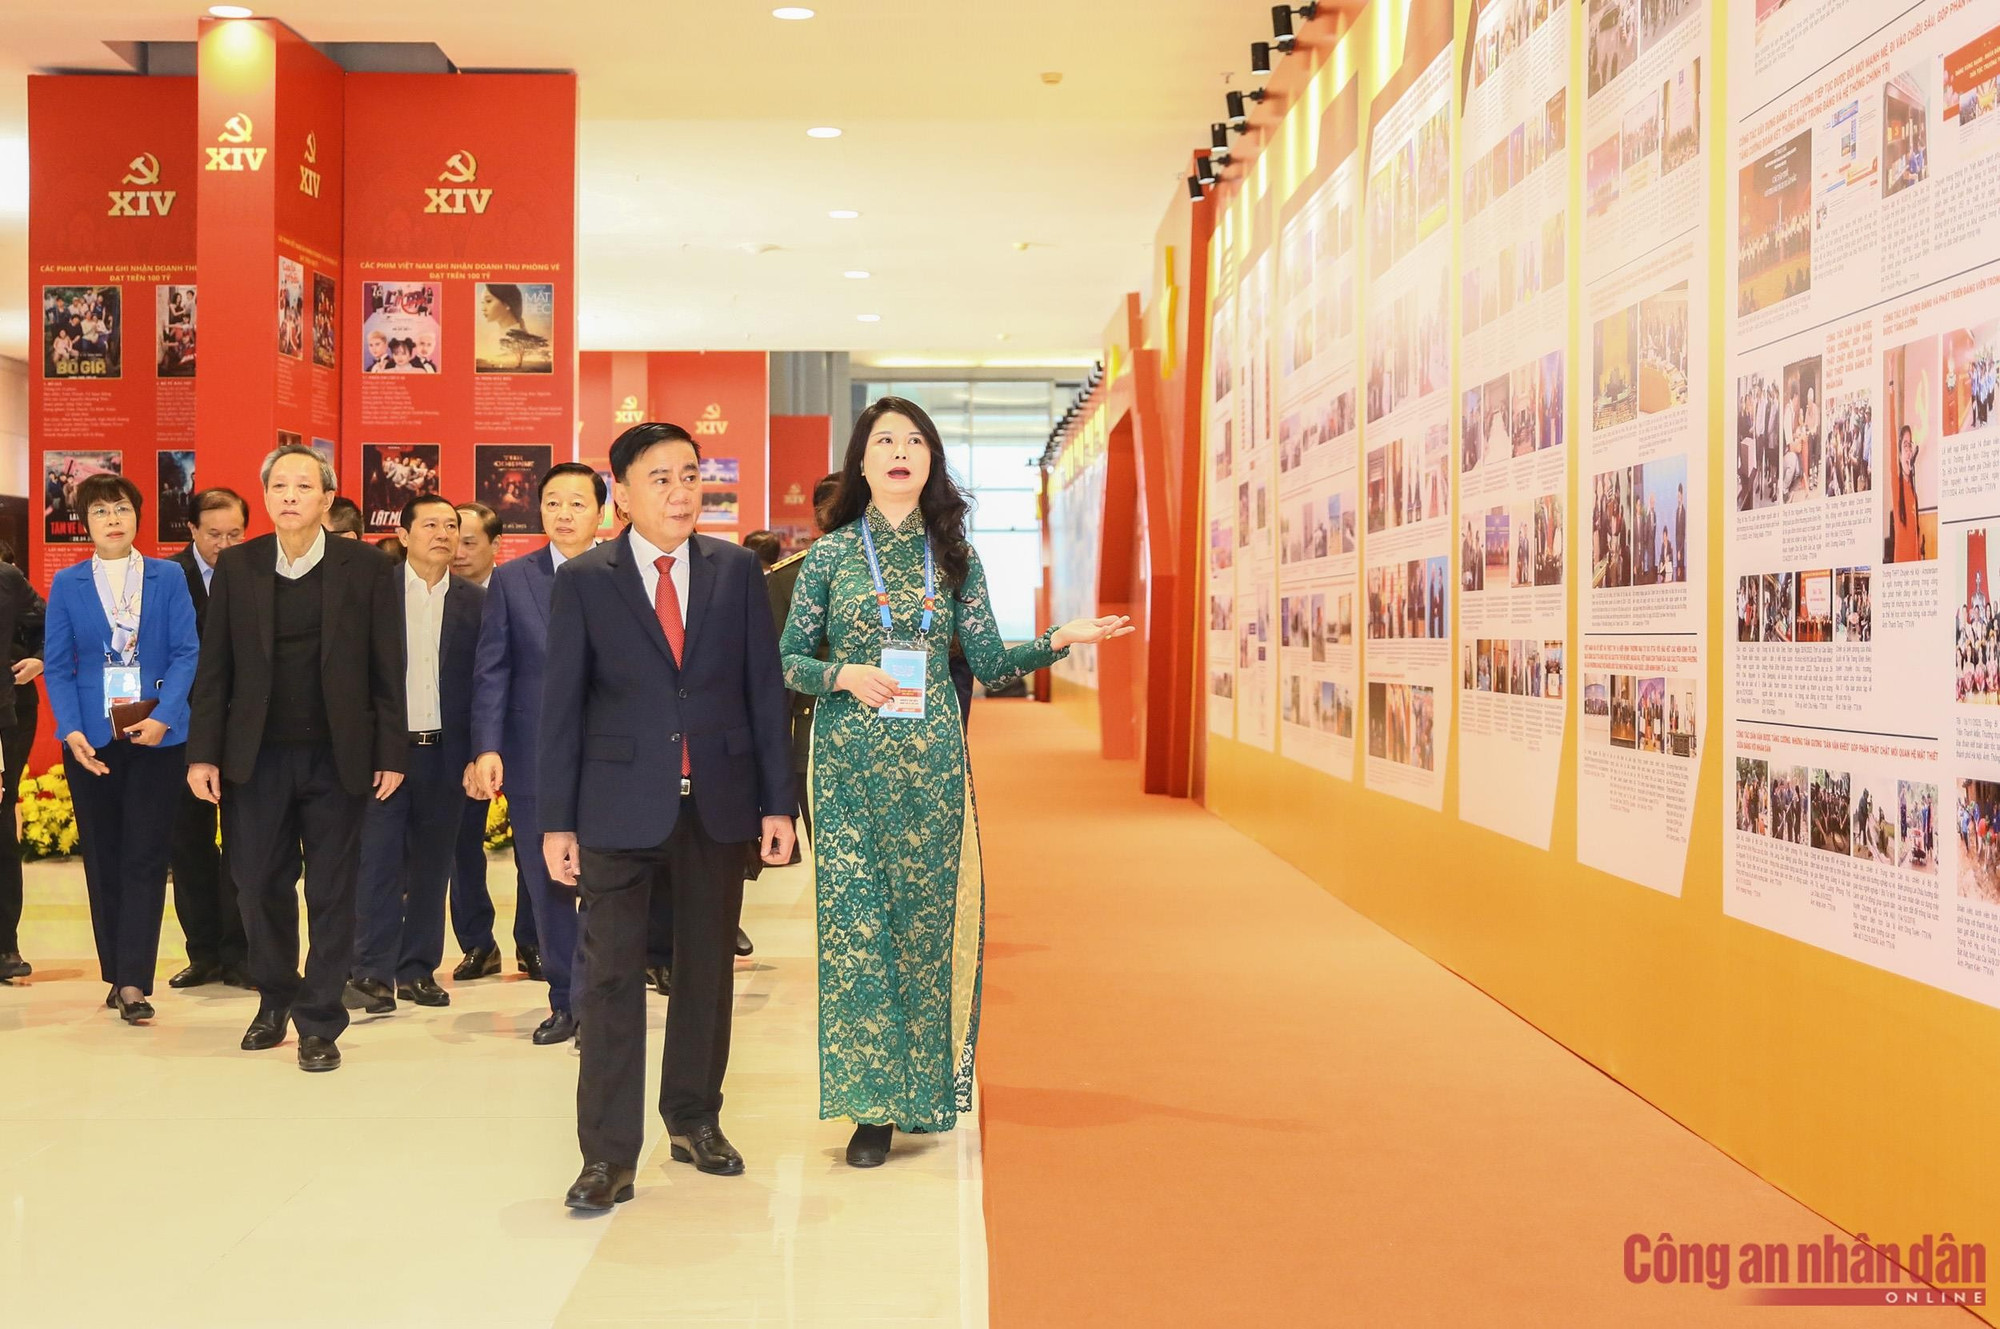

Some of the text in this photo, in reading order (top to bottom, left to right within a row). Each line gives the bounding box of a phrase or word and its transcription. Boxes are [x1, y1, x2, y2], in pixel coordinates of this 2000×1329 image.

[205, 148, 267, 171] XIV
[300, 165, 320, 198] XIV
[108, 191, 176, 216] XIV
[424, 188, 493, 214] XIV
[40, 264, 54, 272] CÁC
[78, 264, 93, 273] VIỆT
[131, 264, 153, 273] NHẬN
[360, 261, 374, 269] CÁC
[398, 261, 414, 270] VIỆT
[451, 262, 473, 271] NHẬN
[522, 262, 549, 270] PHÒNG
[551, 262, 560, 270] VÉ
[615, 411, 644, 423] XIV
[695, 421, 728, 434] XIV
[784, 494, 806, 504] XIV
